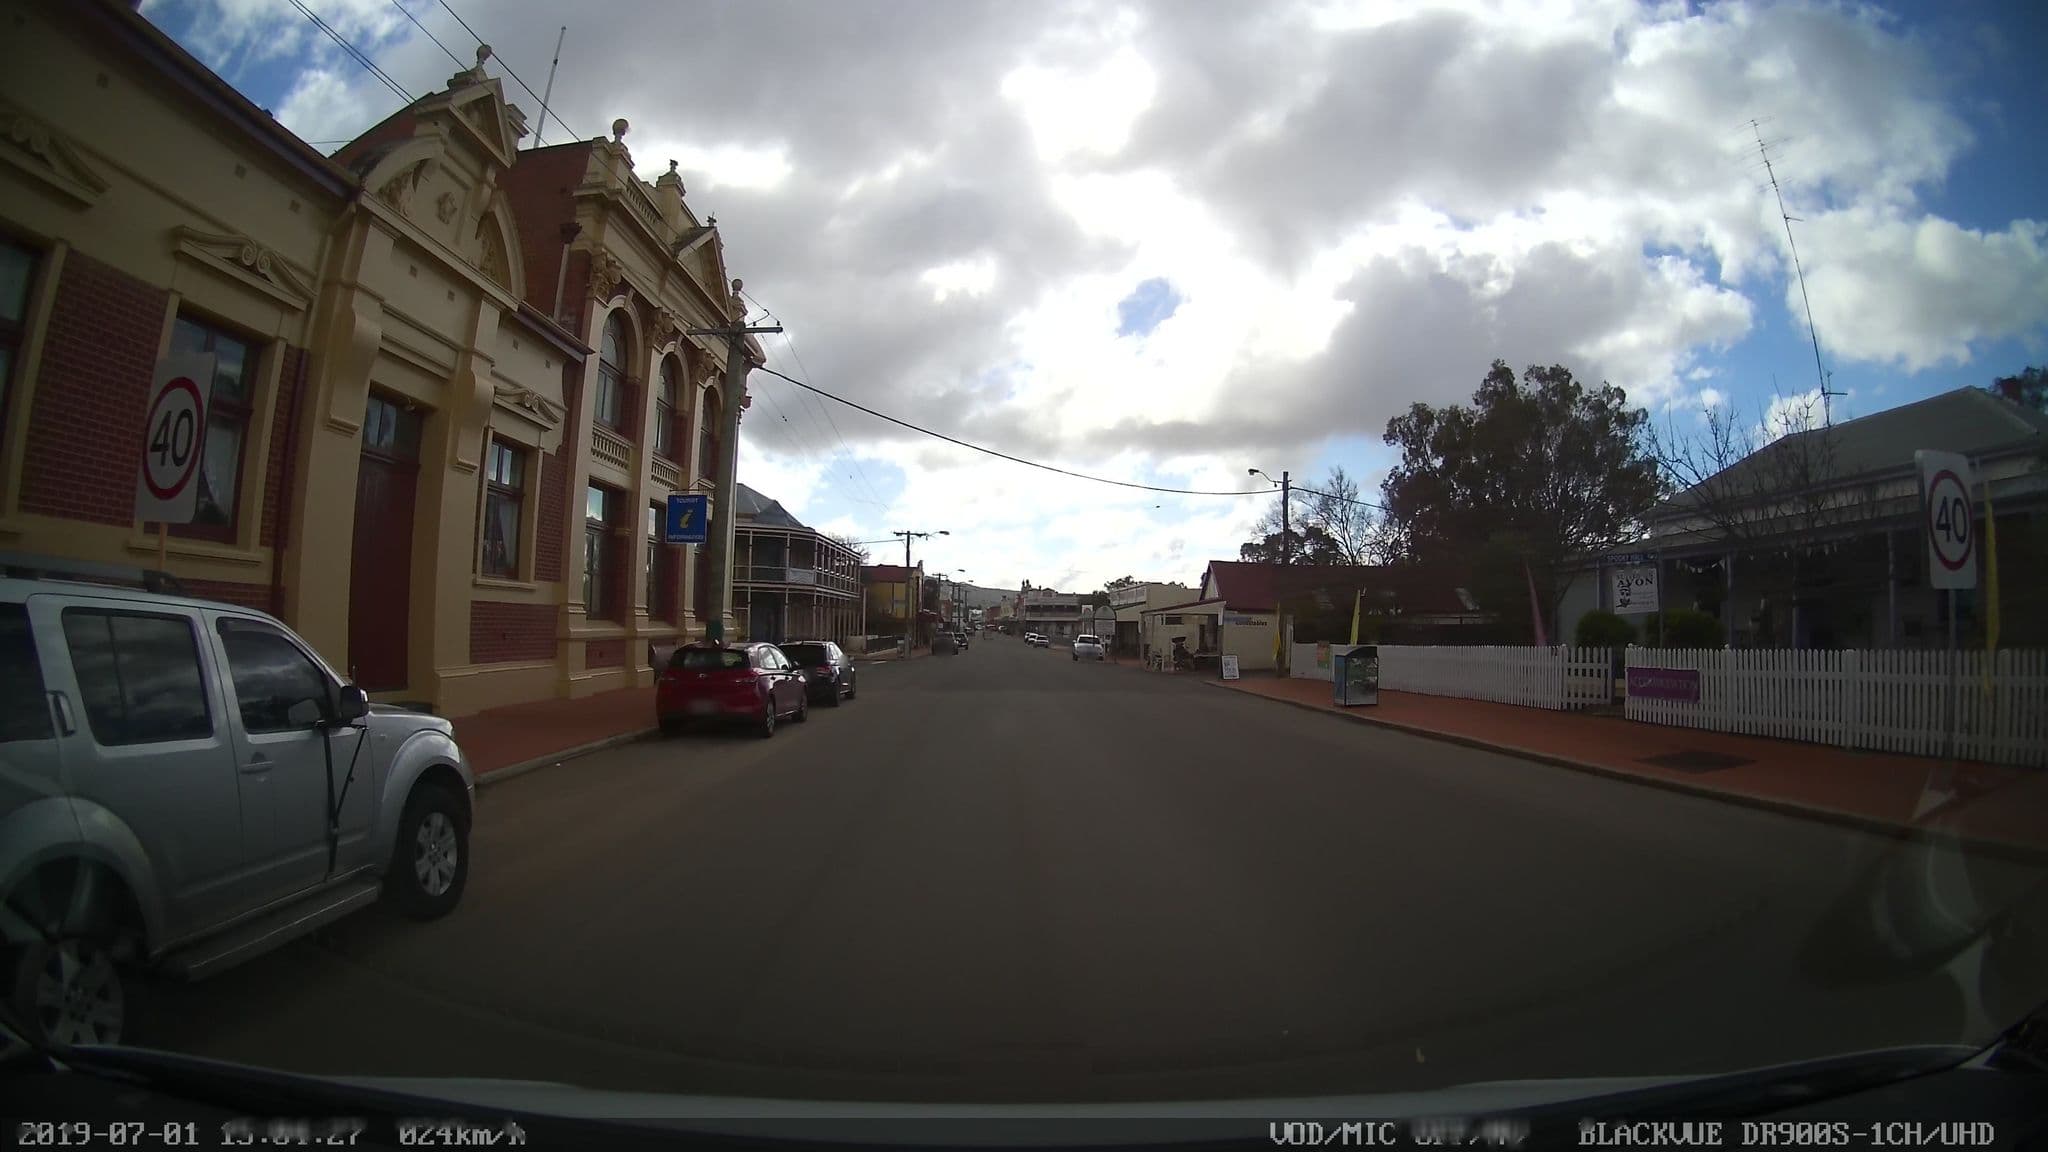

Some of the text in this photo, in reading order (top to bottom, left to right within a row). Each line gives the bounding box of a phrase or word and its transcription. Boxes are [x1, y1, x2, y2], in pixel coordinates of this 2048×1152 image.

[151, 408, 194, 467] 40
[1935, 495, 1967, 544] 40
[1616, 577, 1654, 588] AVON
